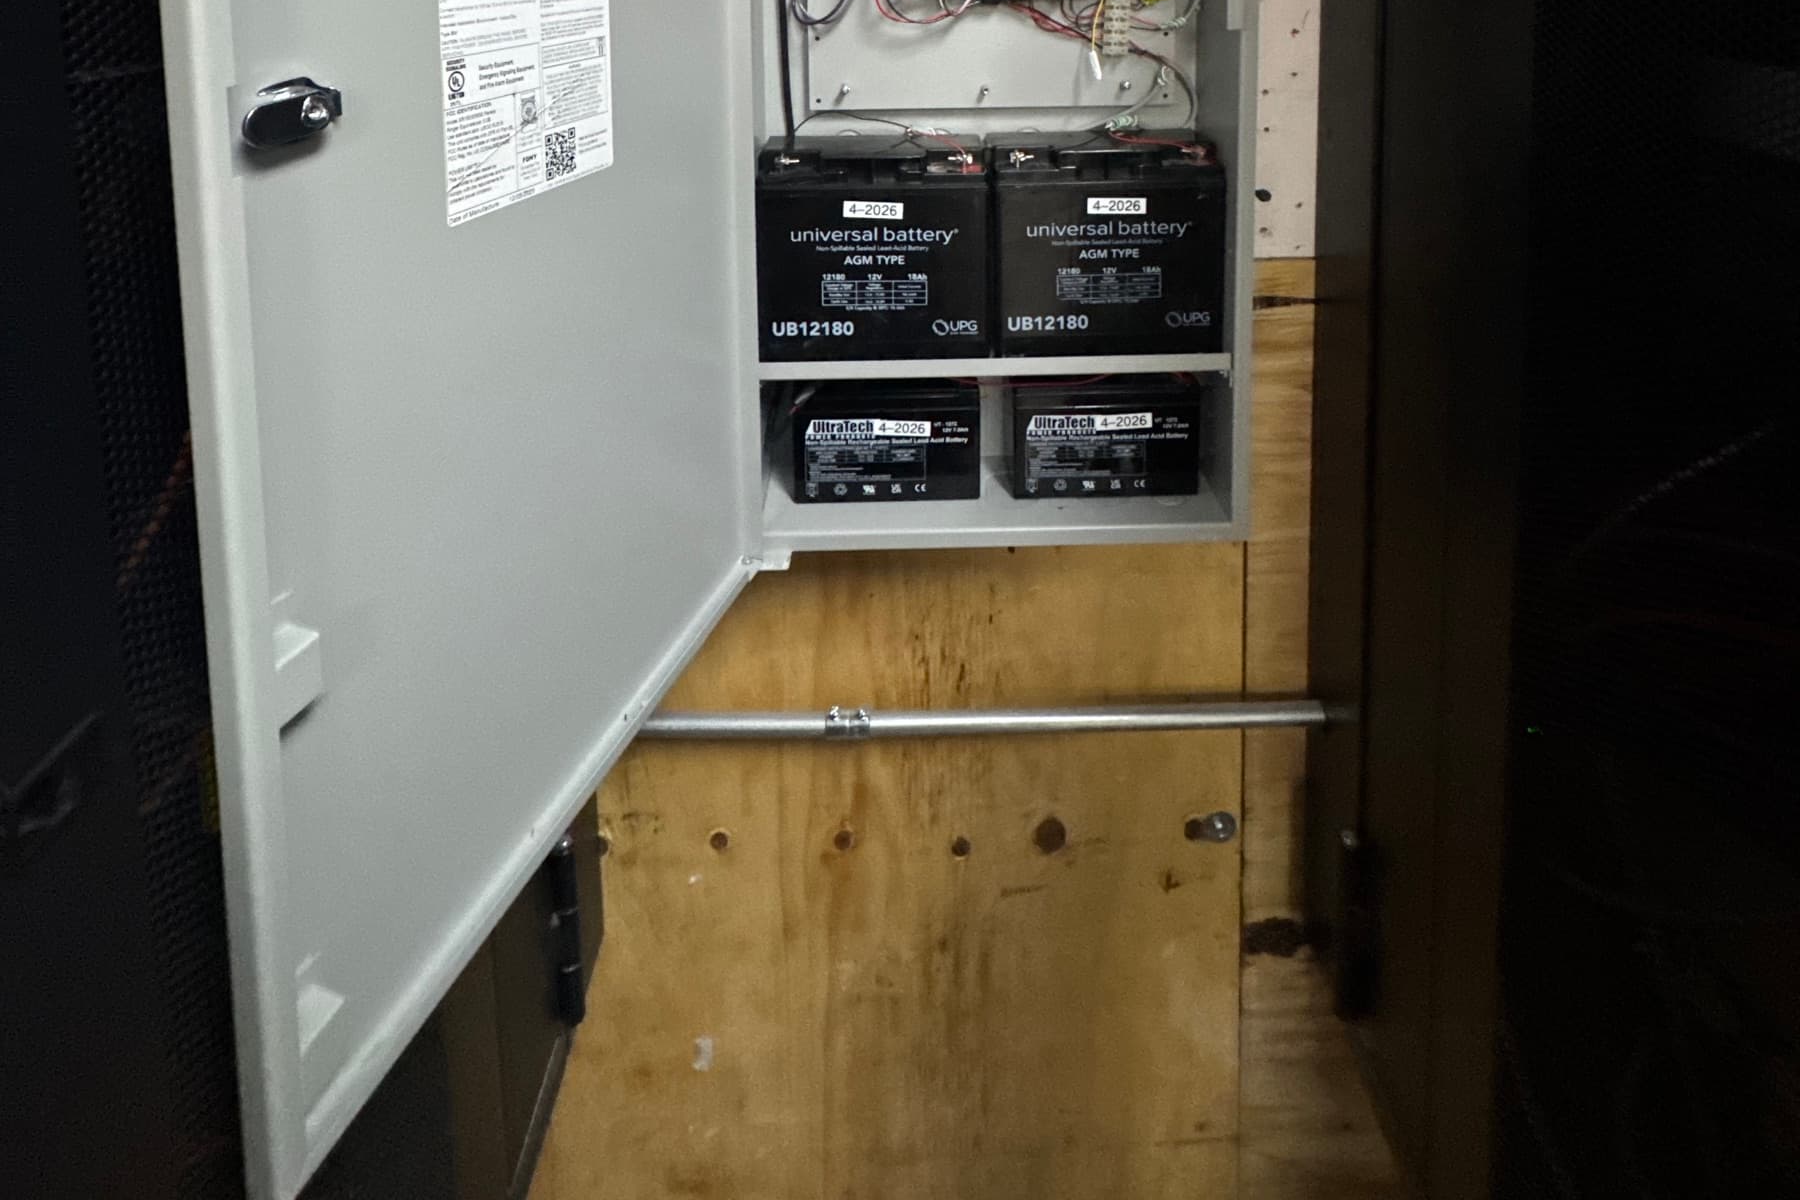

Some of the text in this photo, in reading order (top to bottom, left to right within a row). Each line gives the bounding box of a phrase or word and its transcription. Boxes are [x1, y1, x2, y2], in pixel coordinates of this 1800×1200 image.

[790, 227, 953, 245] universal battery
[1026, 220, 1187, 239] universal battery
[843, 255, 906, 265] AGM TYPE
[1079, 248, 1140, 259] AGM TYPE
[822, 273, 846, 281] 12180
[867, 273, 883, 281] 12V
[1057, 267, 1081, 275] 12180
[1007, 314, 1089, 332] UB12180
[1182, 311, 1211, 323] UPG
[772, 321, 855, 337] UB12180
[950, 319, 978, 332] UPG
[812, 420, 874, 434] UltraTech
[1034, 415, 1095, 429] UltraTech
